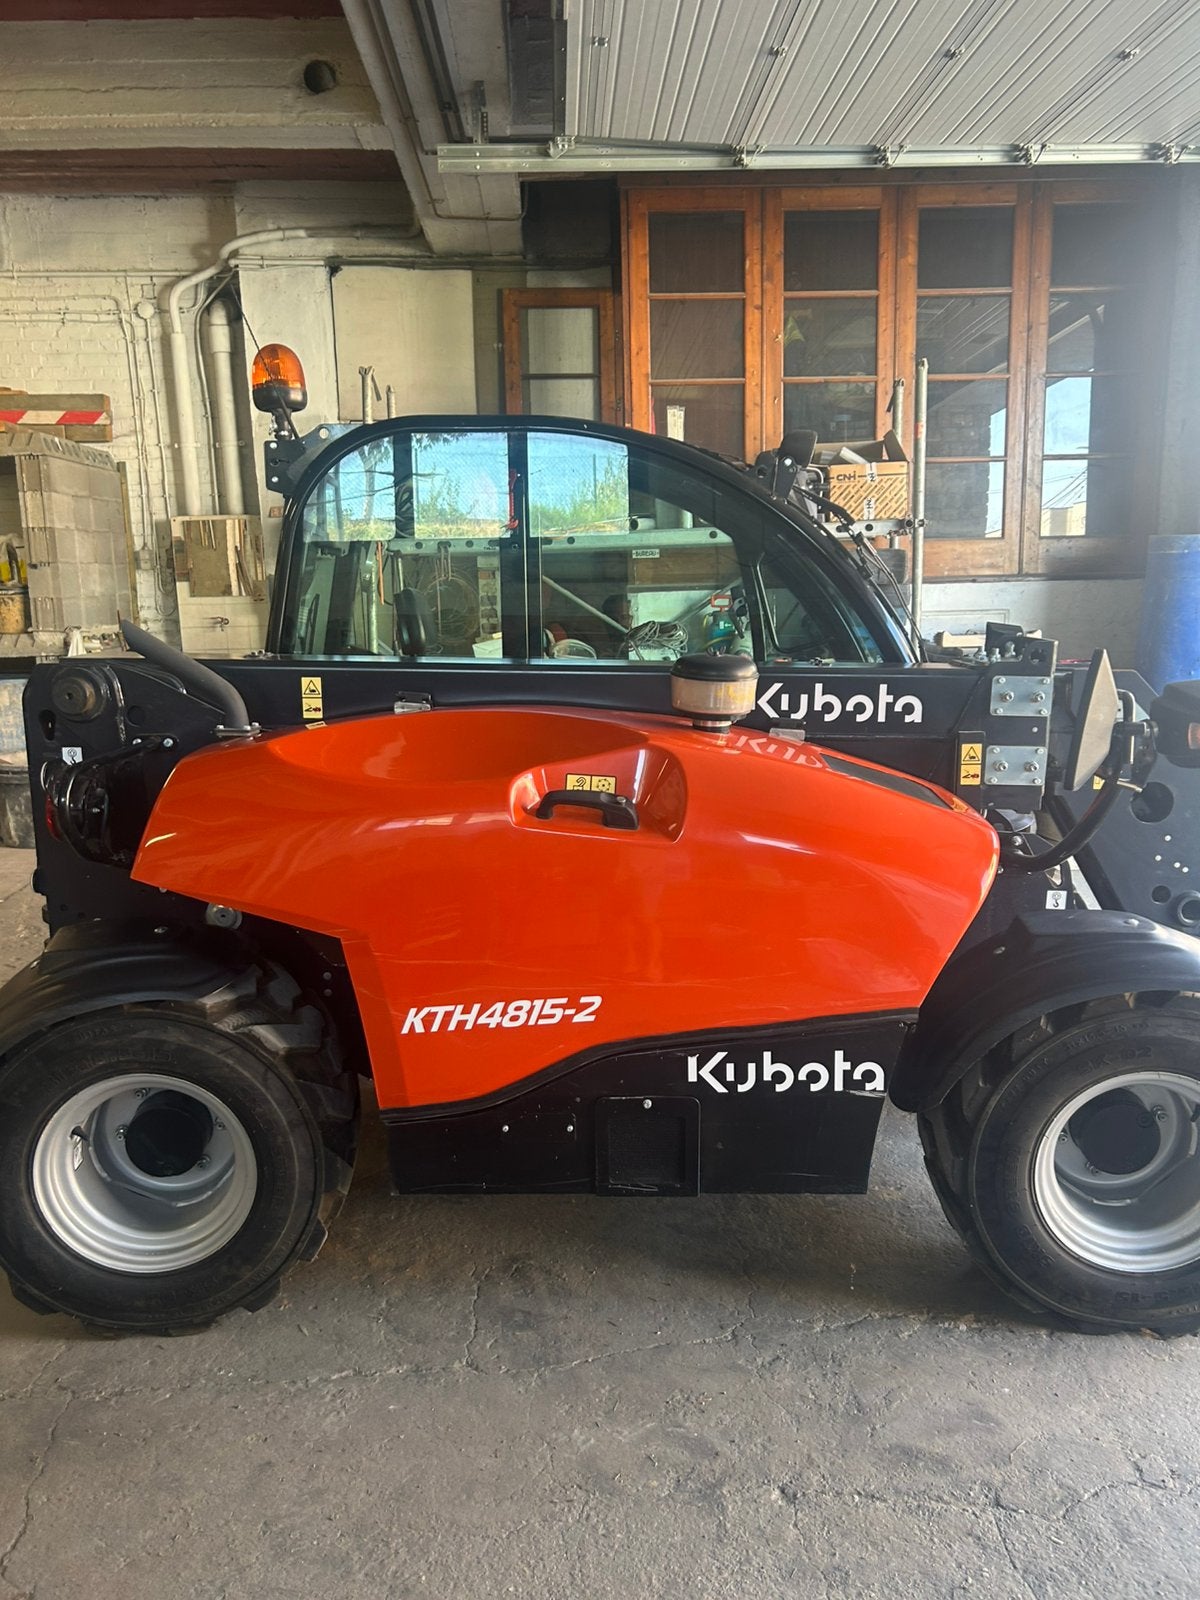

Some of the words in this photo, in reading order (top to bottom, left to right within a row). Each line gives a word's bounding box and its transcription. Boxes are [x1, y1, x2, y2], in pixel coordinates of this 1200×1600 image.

[752, 682, 923, 723] Kubota
[401, 995, 603, 1036] KTH4815-2
[687, 1050, 886, 1094] Kubota
